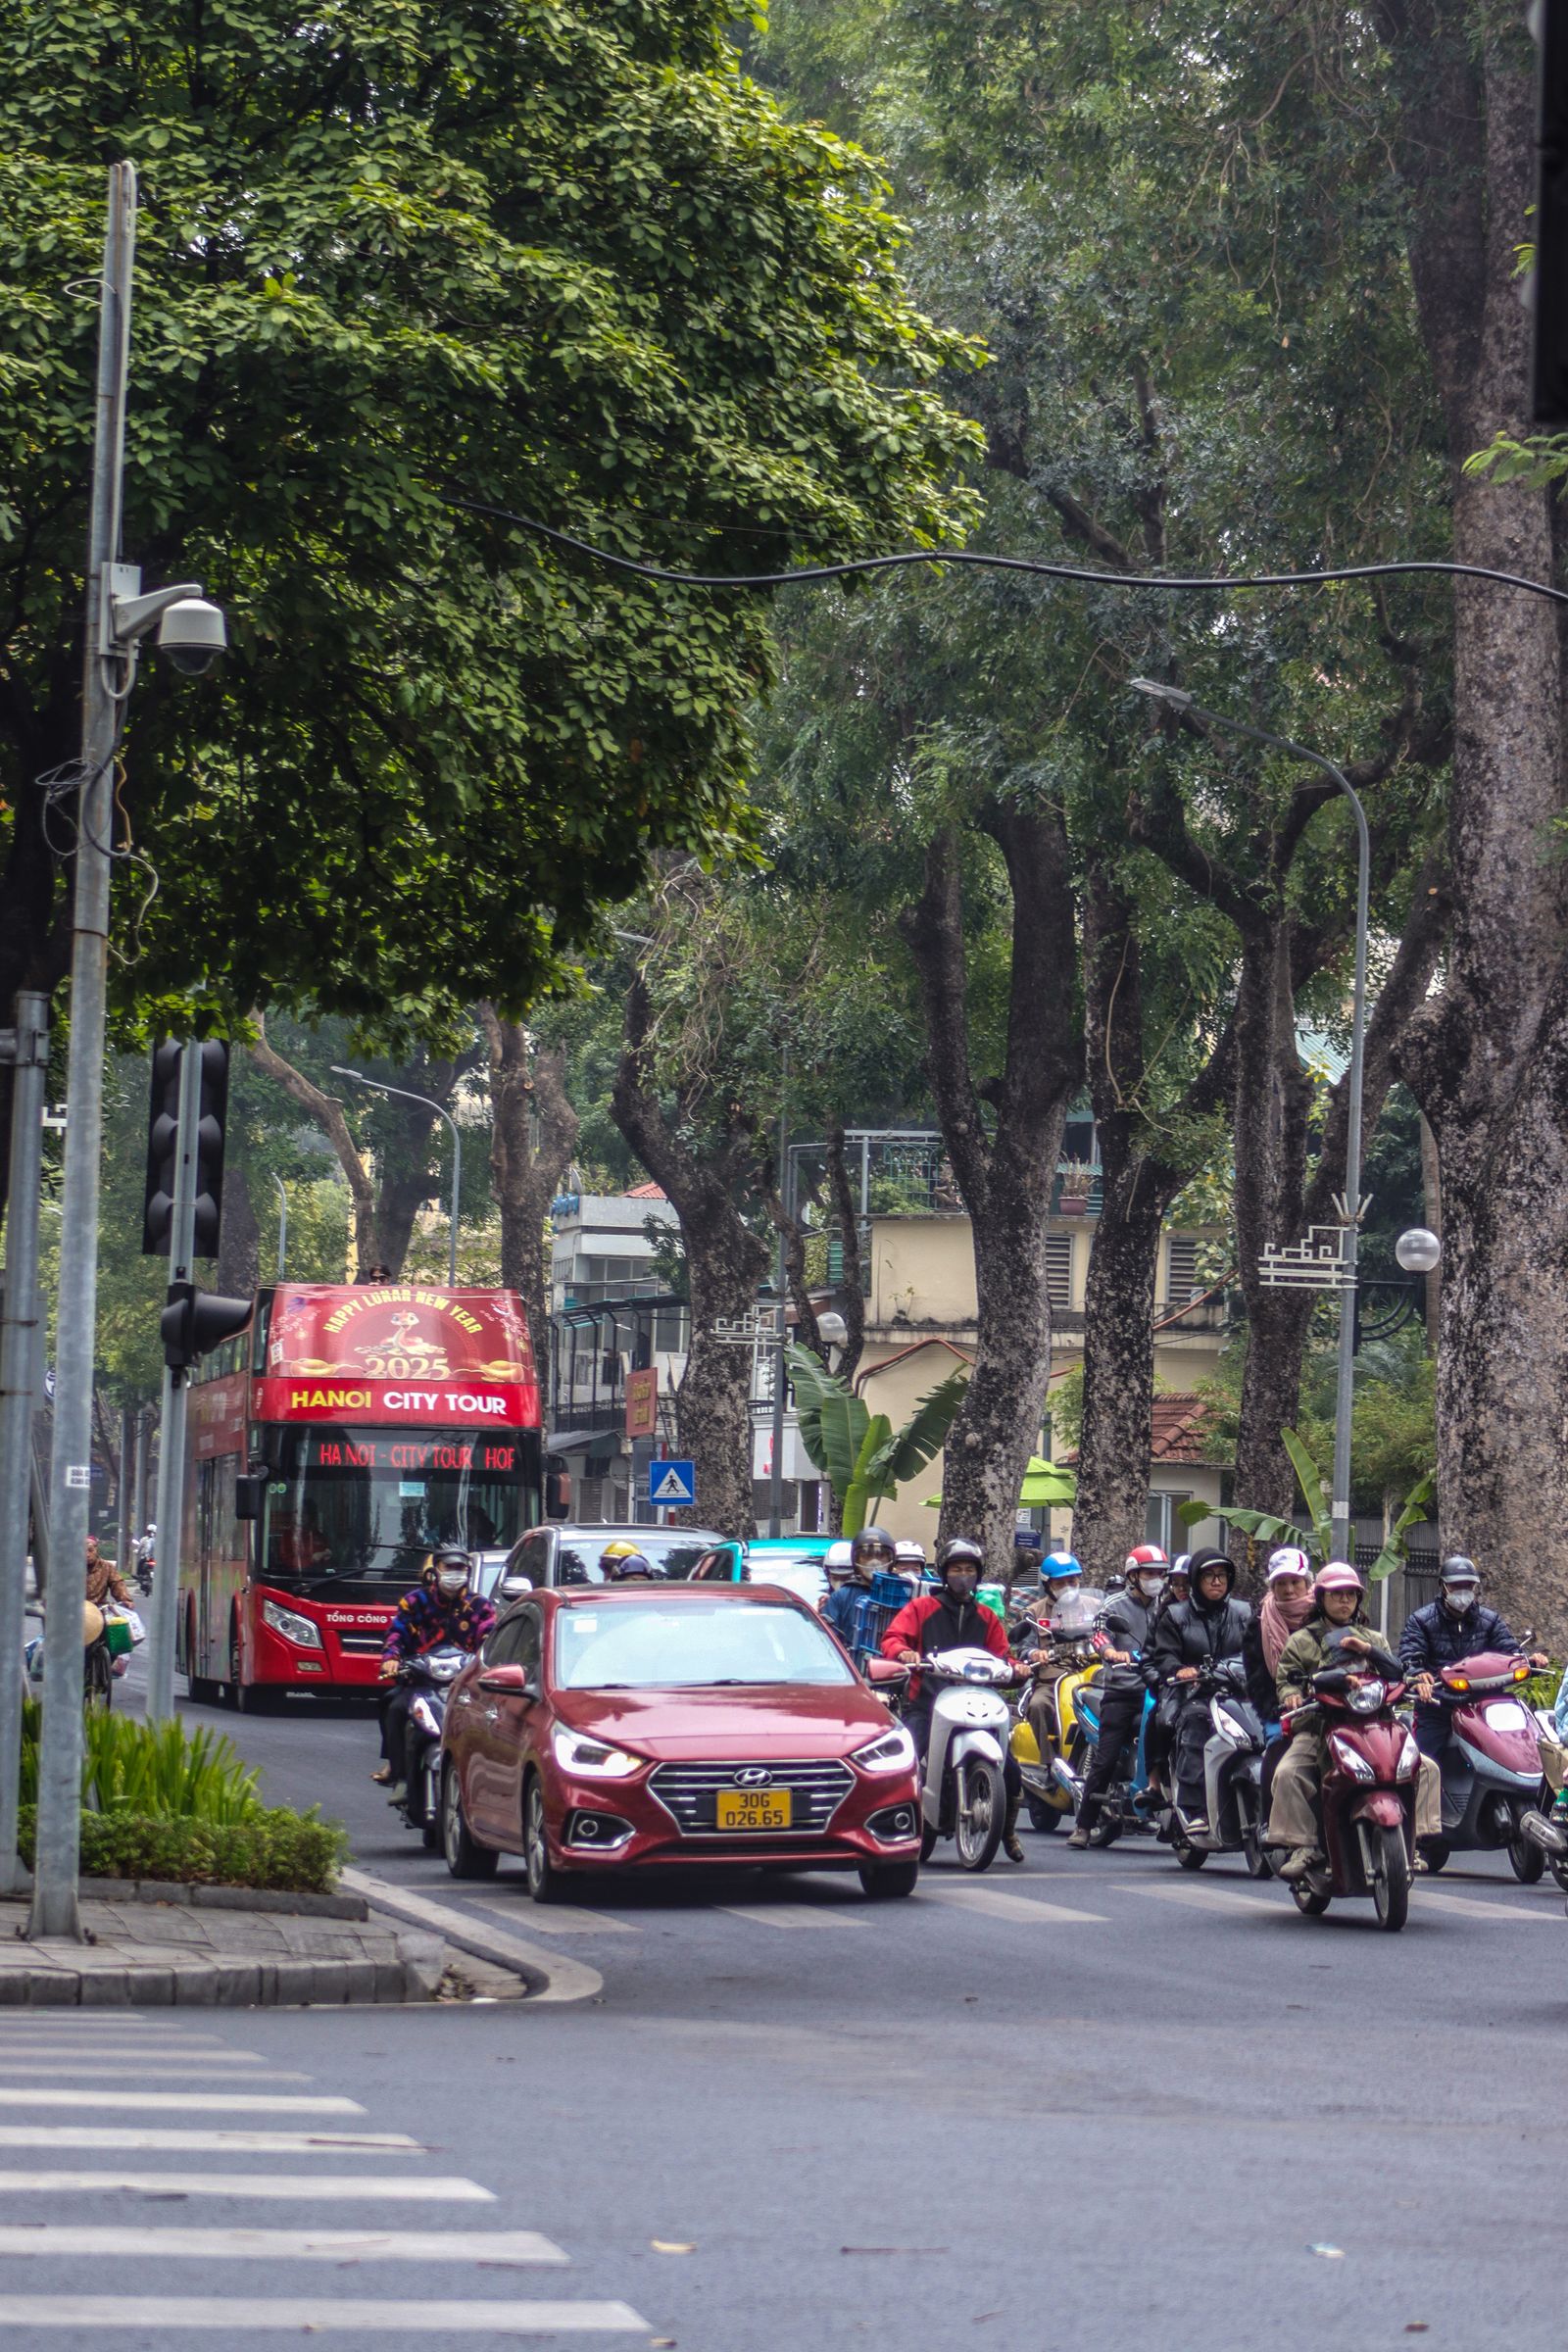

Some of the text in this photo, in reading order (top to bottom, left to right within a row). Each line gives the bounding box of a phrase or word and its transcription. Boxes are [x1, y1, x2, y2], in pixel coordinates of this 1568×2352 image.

[322, 1289, 483, 1334] HAPPY LUNAR NEW YEAR
[364, 1355, 451, 1380] 2025
[291, 1391, 507, 1415] HANOI CITY TOUR
[390, 1444, 425, 1467] CITY
[433, 1446, 472, 1469] TOUR
[357, 1613, 388, 1623] CÔNG
[739, 1792, 770, 1808] 30G
[726, 1810, 784, 1826] 026.65
